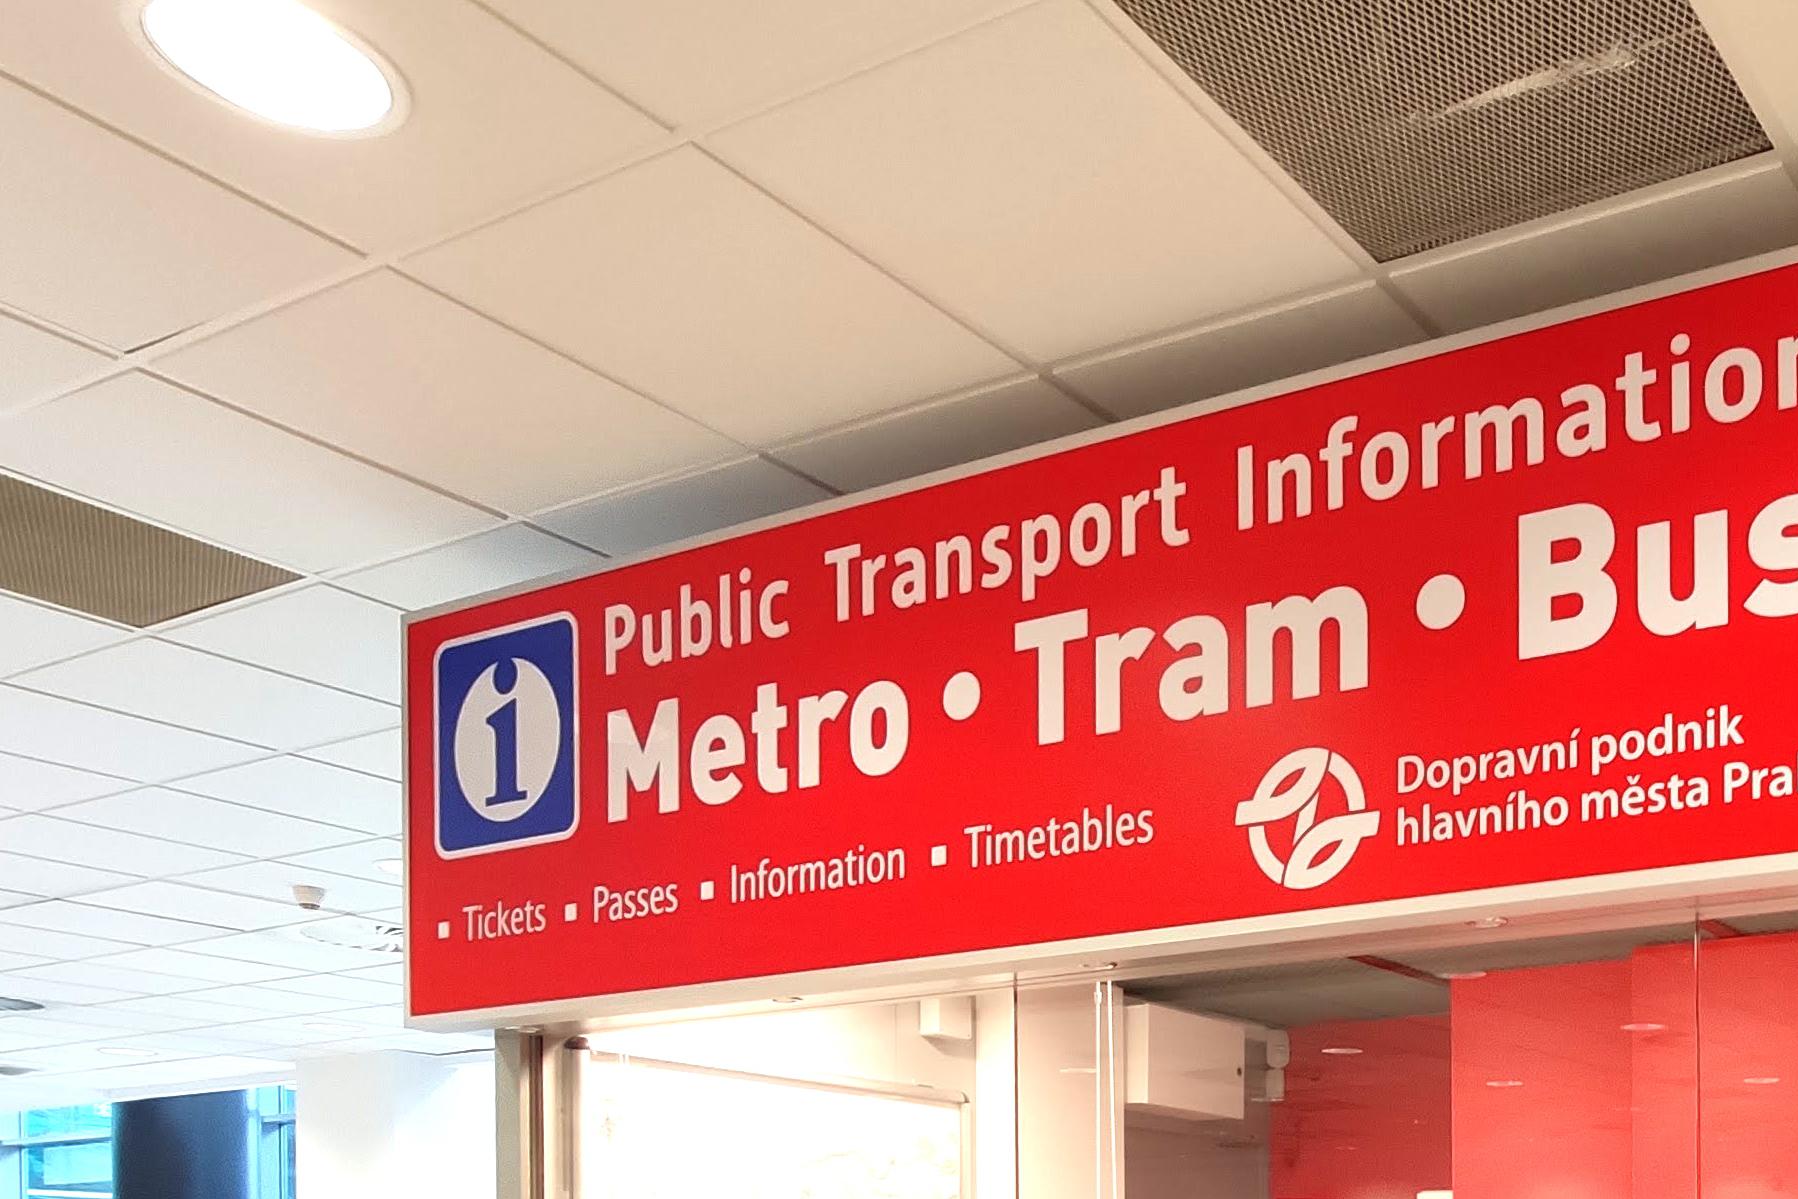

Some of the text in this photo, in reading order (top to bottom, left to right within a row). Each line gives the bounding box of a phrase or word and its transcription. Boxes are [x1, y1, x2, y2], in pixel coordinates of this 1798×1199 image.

[606, 567, 789, 675] Public
[825, 467, 1189, 621] Transport
[607, 681, 909, 823] Metro
[1014, 587, 1368, 745] Tram
[1397, 704, 1745, 796] Dopravní podnik
[463, 804, 1154, 942] Tickets Passes Information Timetables
[1397, 790, 1569, 846] hlavního
[1581, 775, 1709, 822] města
